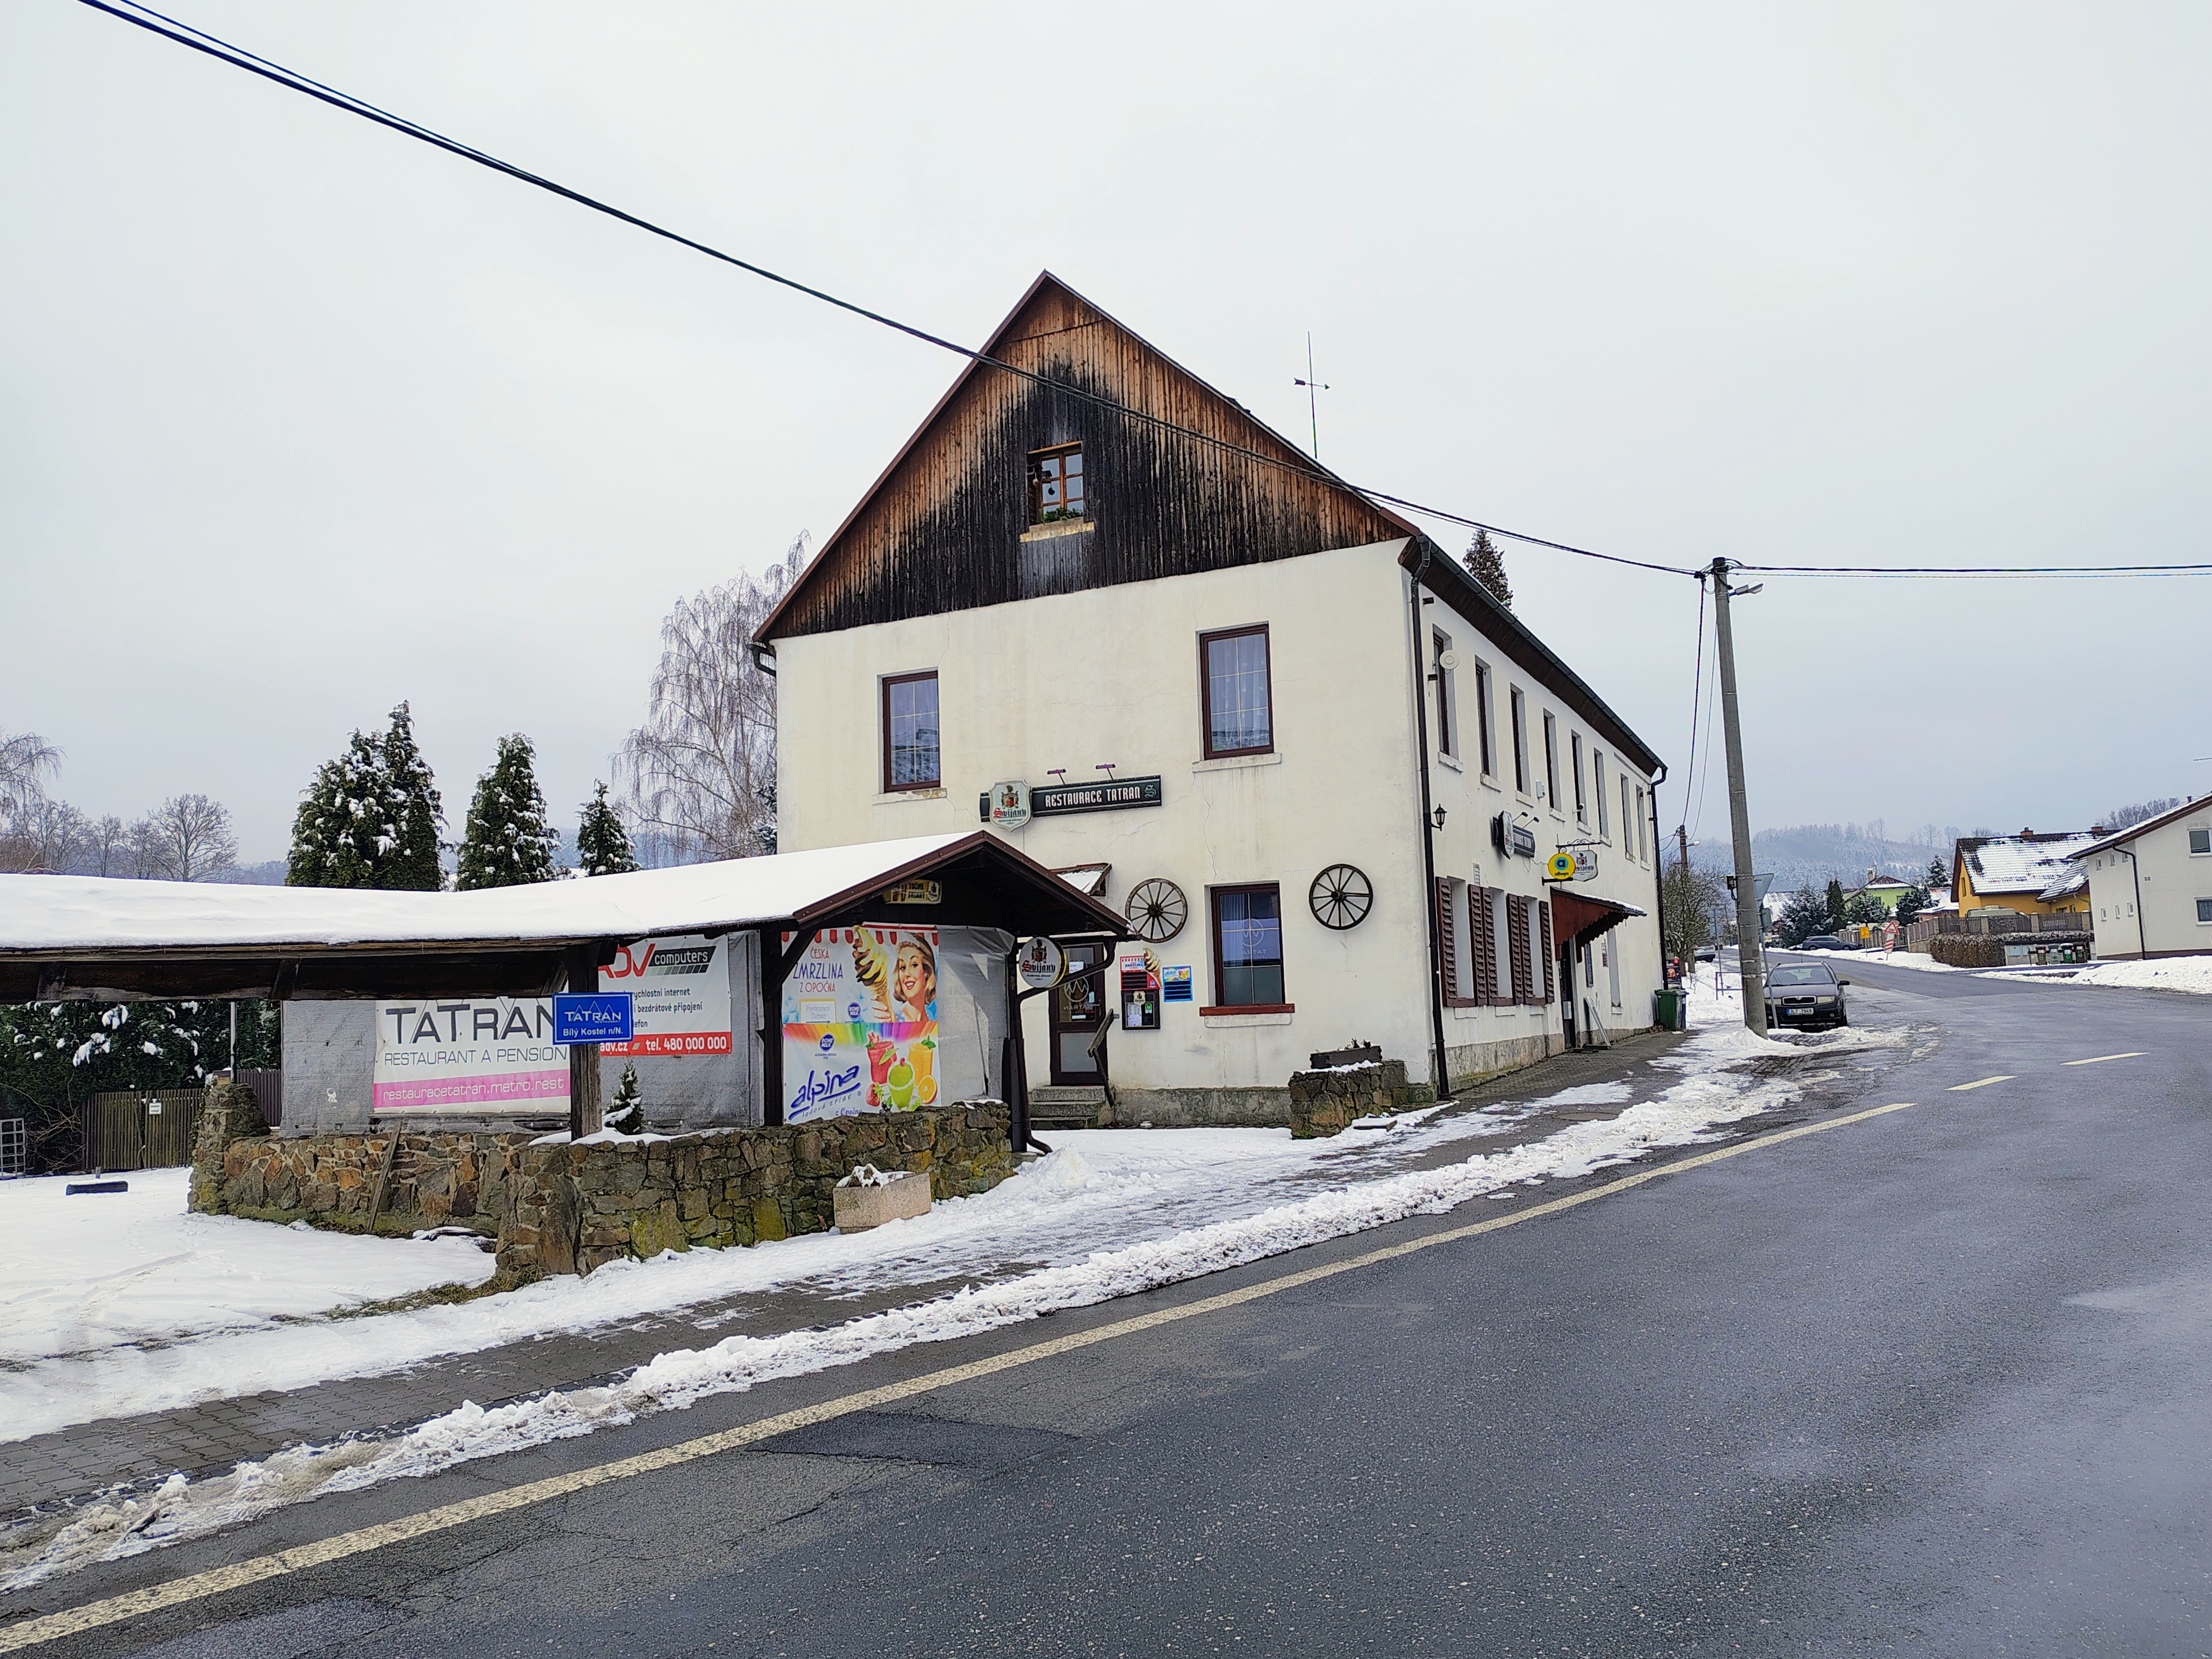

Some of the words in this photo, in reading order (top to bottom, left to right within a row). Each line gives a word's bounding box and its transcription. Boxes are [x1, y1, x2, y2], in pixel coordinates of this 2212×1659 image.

[1045, 790, 1102, 808] RESTAURACE
[1106, 786, 1141, 802] TATRAN
[994, 807, 1026, 819] Svijany
[654, 950, 708, 965] computers
[810, 947, 830, 959] ČESKÁ
[793, 962, 844, 980] ZMRZLINA
[1022, 960, 1056, 974] Svijany
[664, 987, 691, 997] internet
[805, 980, 836, 993] OPOČNA
[637, 1002, 672, 1013] bezdrátové
[674, 1001, 703, 1014] připojení
[564, 1011, 621, 1021] TATRAN
[634, 1019, 648, 1028] efon
[563, 1028, 579, 1038] Bílý
[581, 1027, 606, 1036] Kostel
[608, 1027, 623, 1035] n/N.
[645, 1037, 662, 1051] tel.
[663, 1037, 683, 1051] 480
[685, 1036, 706, 1050] 000
[707, 1036, 727, 1049] 000
[385, 1050, 477, 1066] RESTAURANT
[481, 1049, 491, 1063] A
[497, 1047, 567, 1063] PENSION
[383, 1077, 564, 1101] restauracetatran.metro.rest
[791, 1065, 860, 1108] alpina
[802, 1103, 826, 1118] ledová
